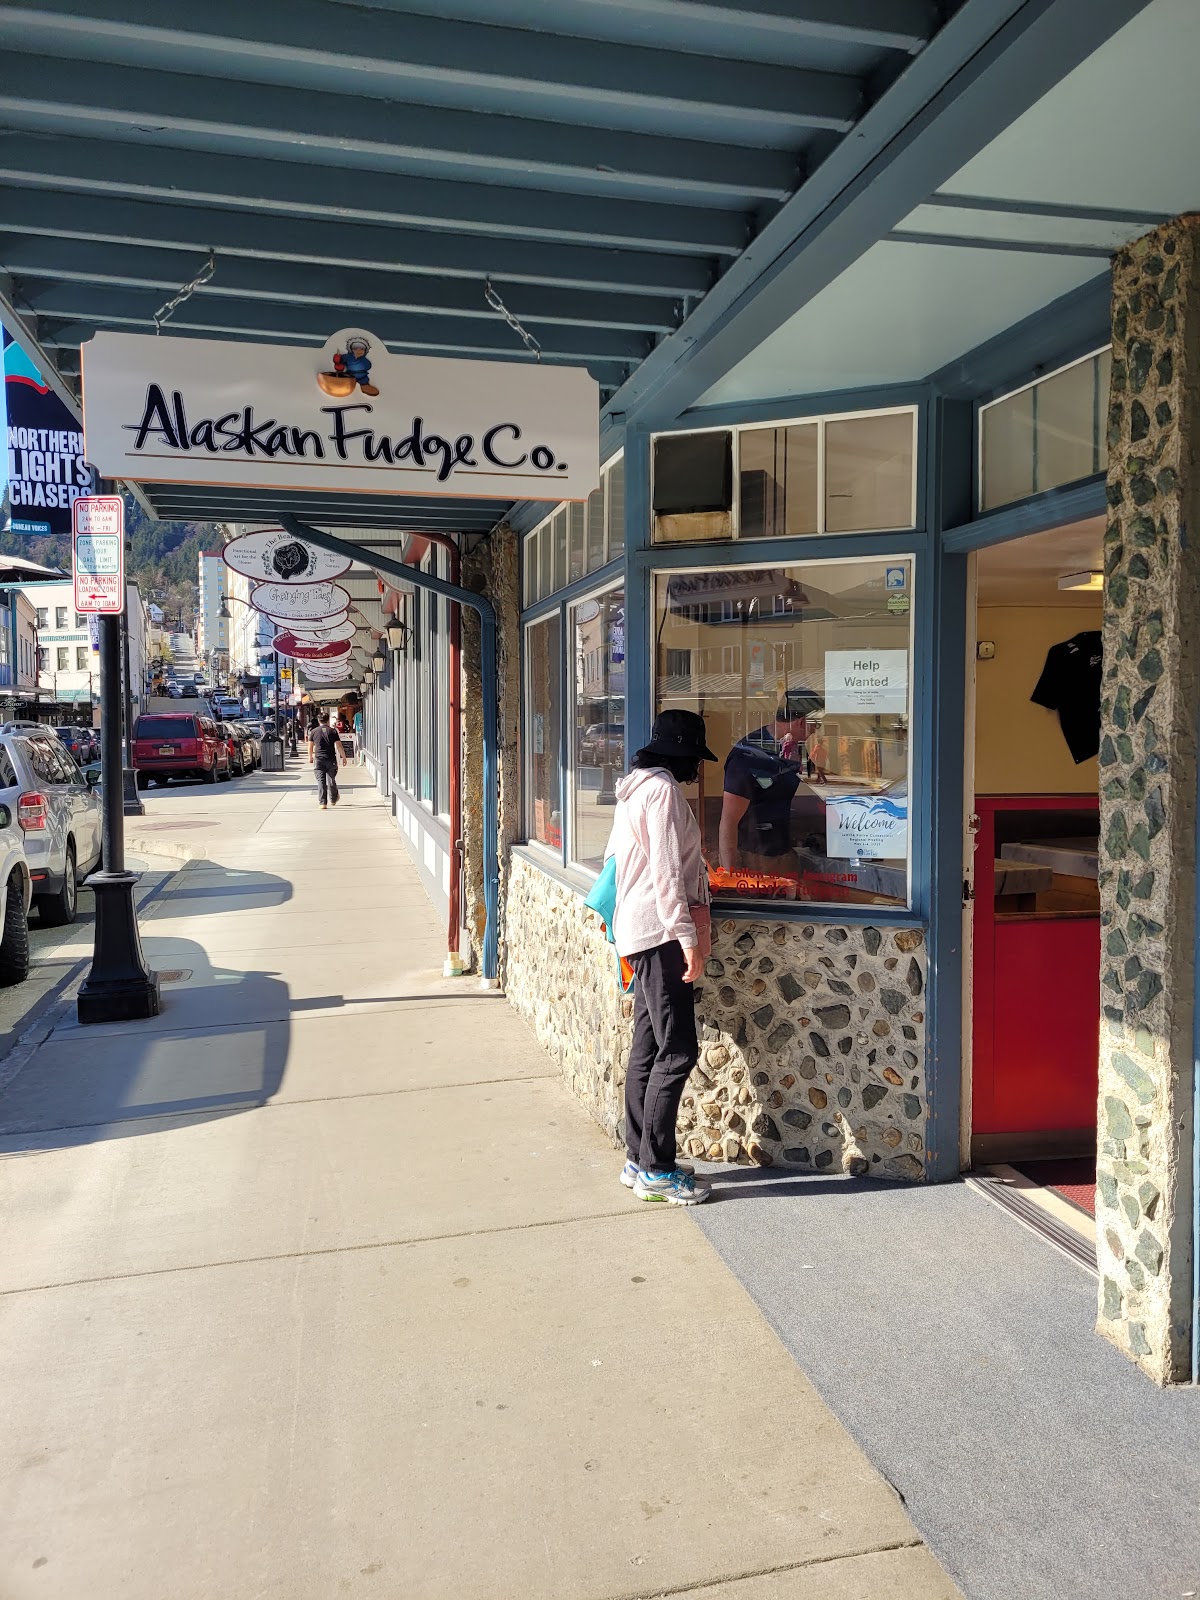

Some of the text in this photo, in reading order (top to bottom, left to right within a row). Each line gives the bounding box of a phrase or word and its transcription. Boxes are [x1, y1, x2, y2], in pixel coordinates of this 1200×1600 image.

[121, 383, 570, 482] Alaskan Fudge Co.
[8, 448, 92, 486] LIGHTS
[80, 504, 118, 512] NO PARKING
[264, 538, 276, 548] The
[269, 586, 310, 605] Changing
[854, 661, 880, 672] Help
[844, 677, 889, 686] Wanted
[839, 812, 896, 831] Welcome
[730, 866, 764, 878] Follow
